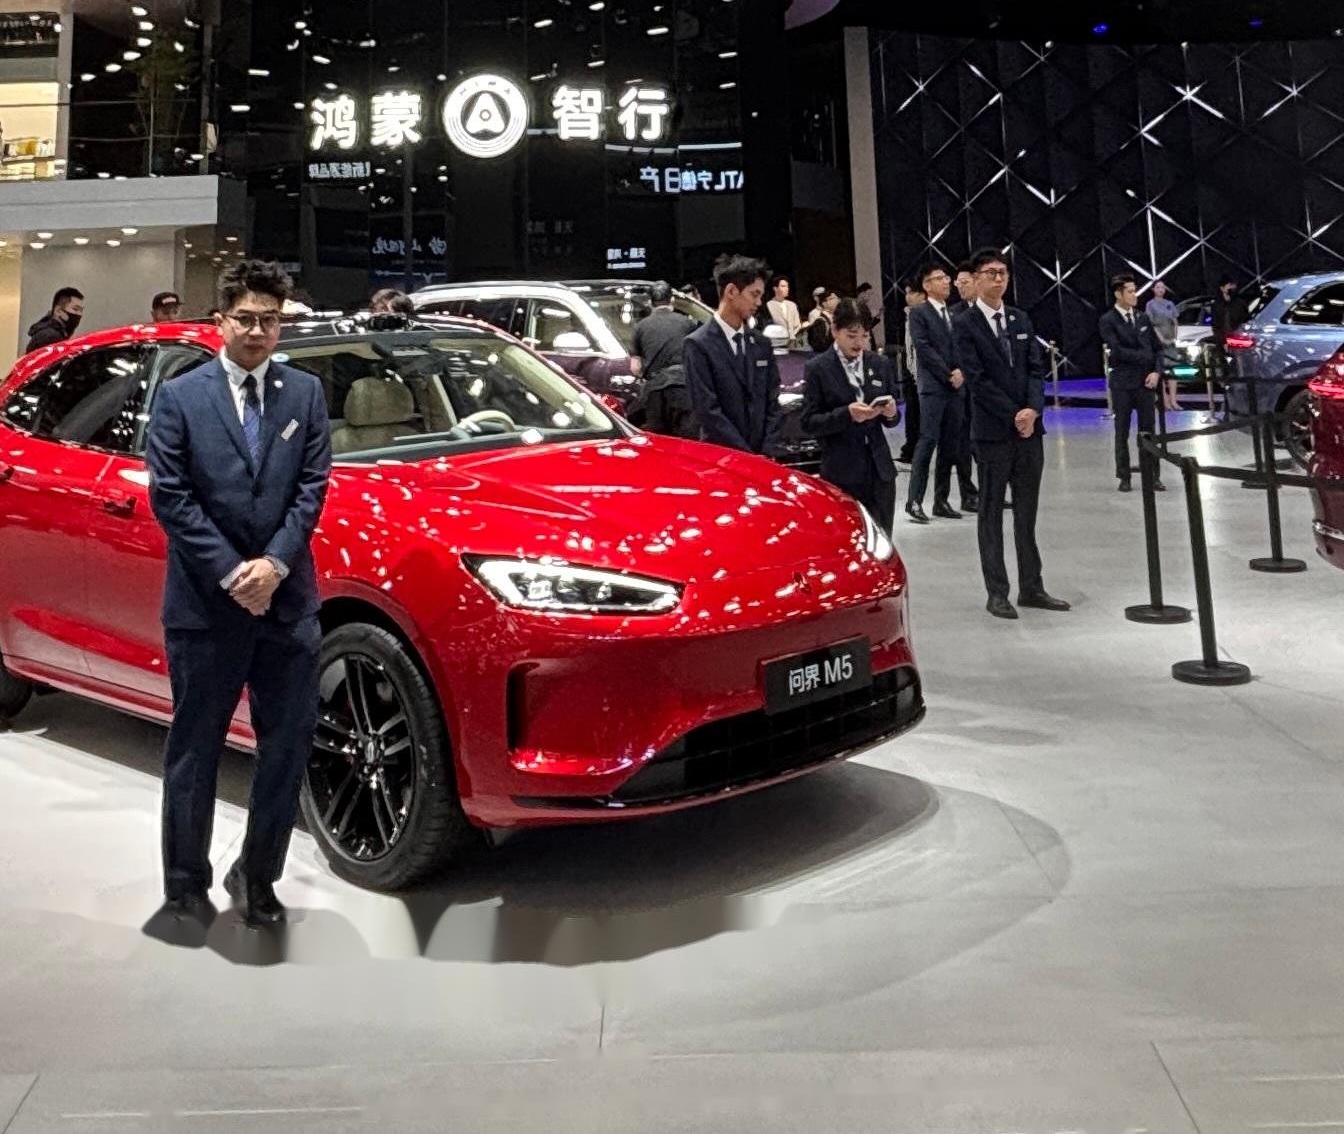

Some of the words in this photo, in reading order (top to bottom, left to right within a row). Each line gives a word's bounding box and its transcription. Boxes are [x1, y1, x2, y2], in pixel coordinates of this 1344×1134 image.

[310, 90, 422, 150] 鸿蒙
[553, 85, 669, 140] 智行
[789, 664, 821, 695] 问界
[824, 654, 853, 684] M5
